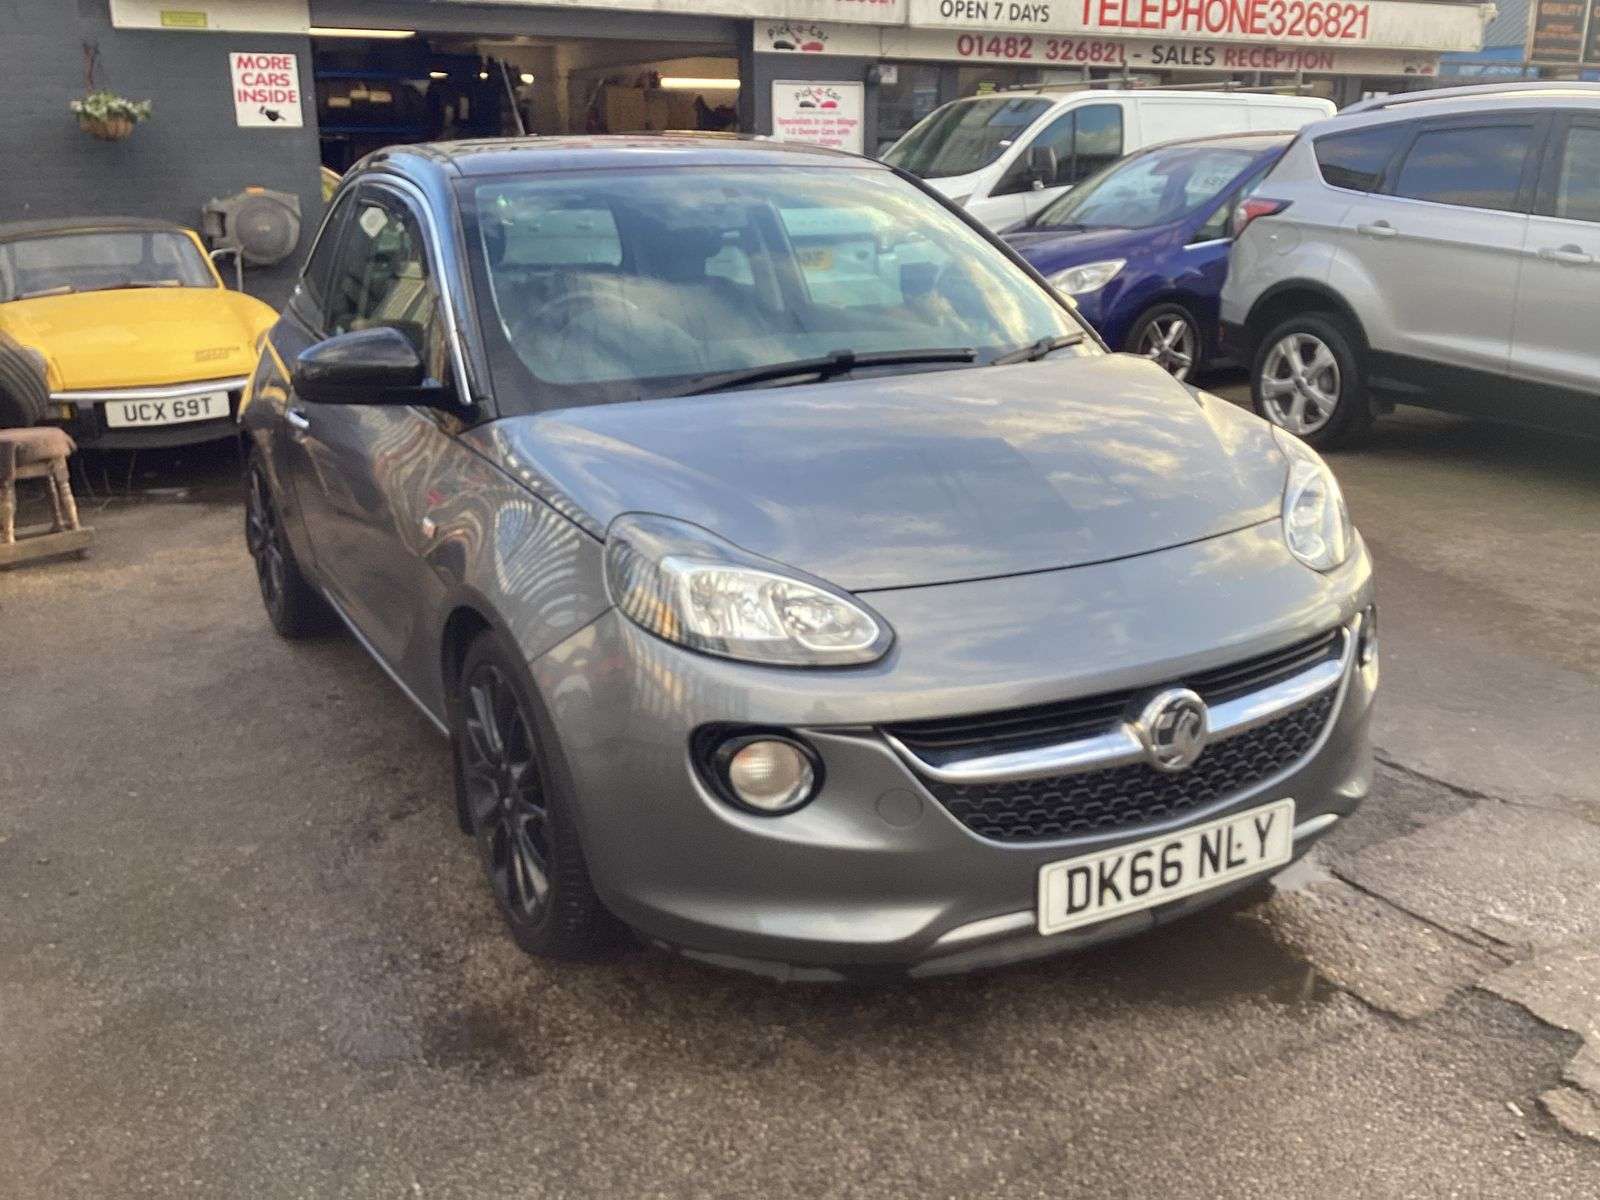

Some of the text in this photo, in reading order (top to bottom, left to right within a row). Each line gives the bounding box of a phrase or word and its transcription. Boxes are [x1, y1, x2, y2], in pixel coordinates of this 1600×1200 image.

[940, 0, 1050, 22] OPEN 7 DAYS
[237, 55, 292, 70] MORE
[957, 33, 1034, 59] 01482
[1045, 39, 1126, 64] 326821
[1152, 45, 1216, 66] SALES
[1223, 48, 1335, 70] RECEPTION
[241, 72, 290, 87] CARS
[237, 89, 297, 103] INSIDE
[124, 397, 212, 422] UCX 69T
[1066, 812, 1275, 916] DK66 NLY
